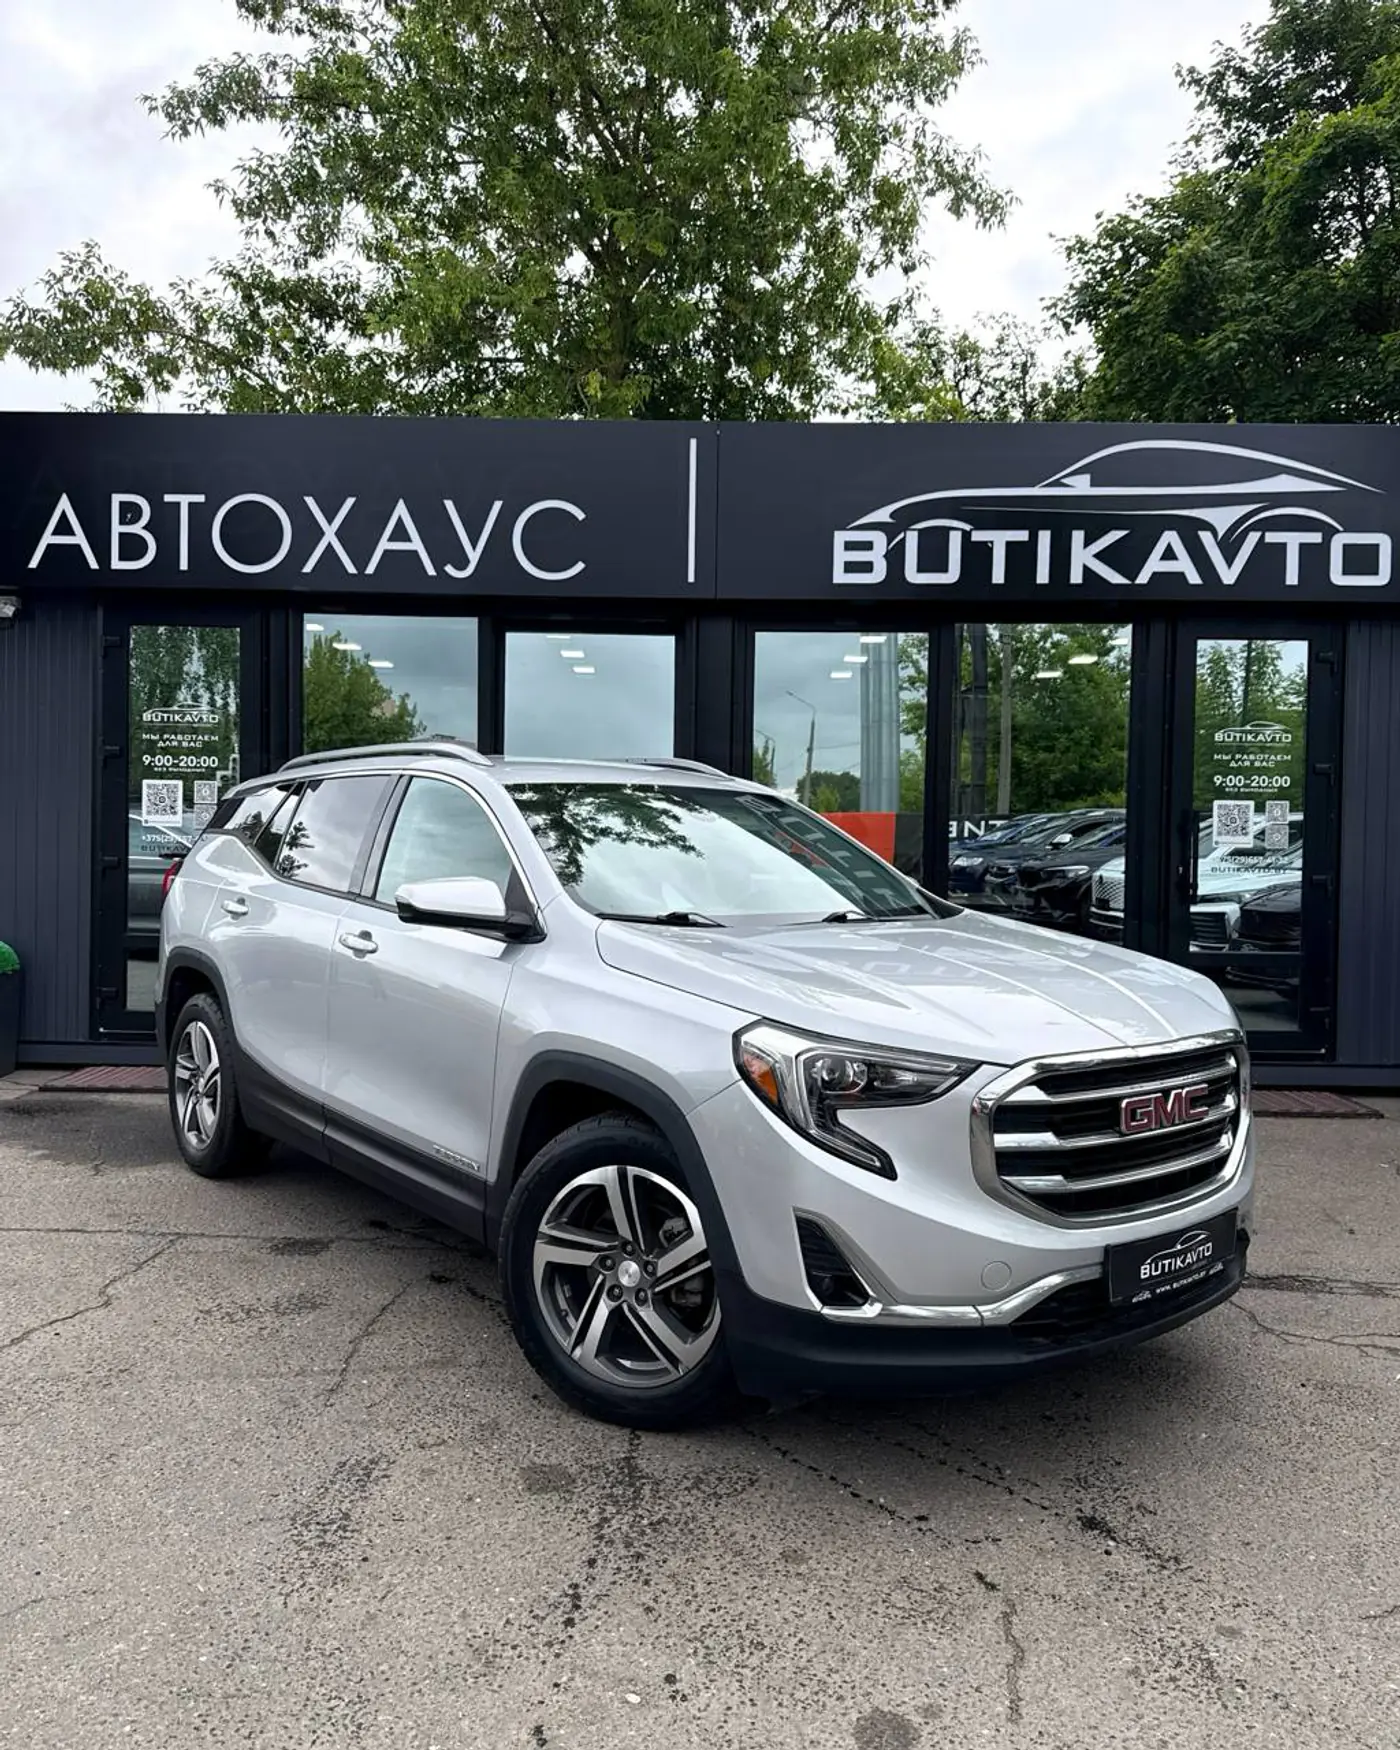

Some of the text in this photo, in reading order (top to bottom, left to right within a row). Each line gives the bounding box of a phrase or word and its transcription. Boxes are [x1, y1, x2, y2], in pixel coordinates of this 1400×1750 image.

[27, 492, 587, 581] АВТОХАУС
[832, 529, 1392, 587] BUTIKAVTO
[142, 712, 219, 723] BUTIKAVTO
[1214, 732, 1292, 743] BUTIKAVTO
[142, 754, 219, 767] 9:00-20:00
[1213, 775, 1291, 787] 9:00-20:00
[1121, 1084, 1209, 1133] GMC
[1140, 1242, 1213, 1280] BUTIKAVTO
